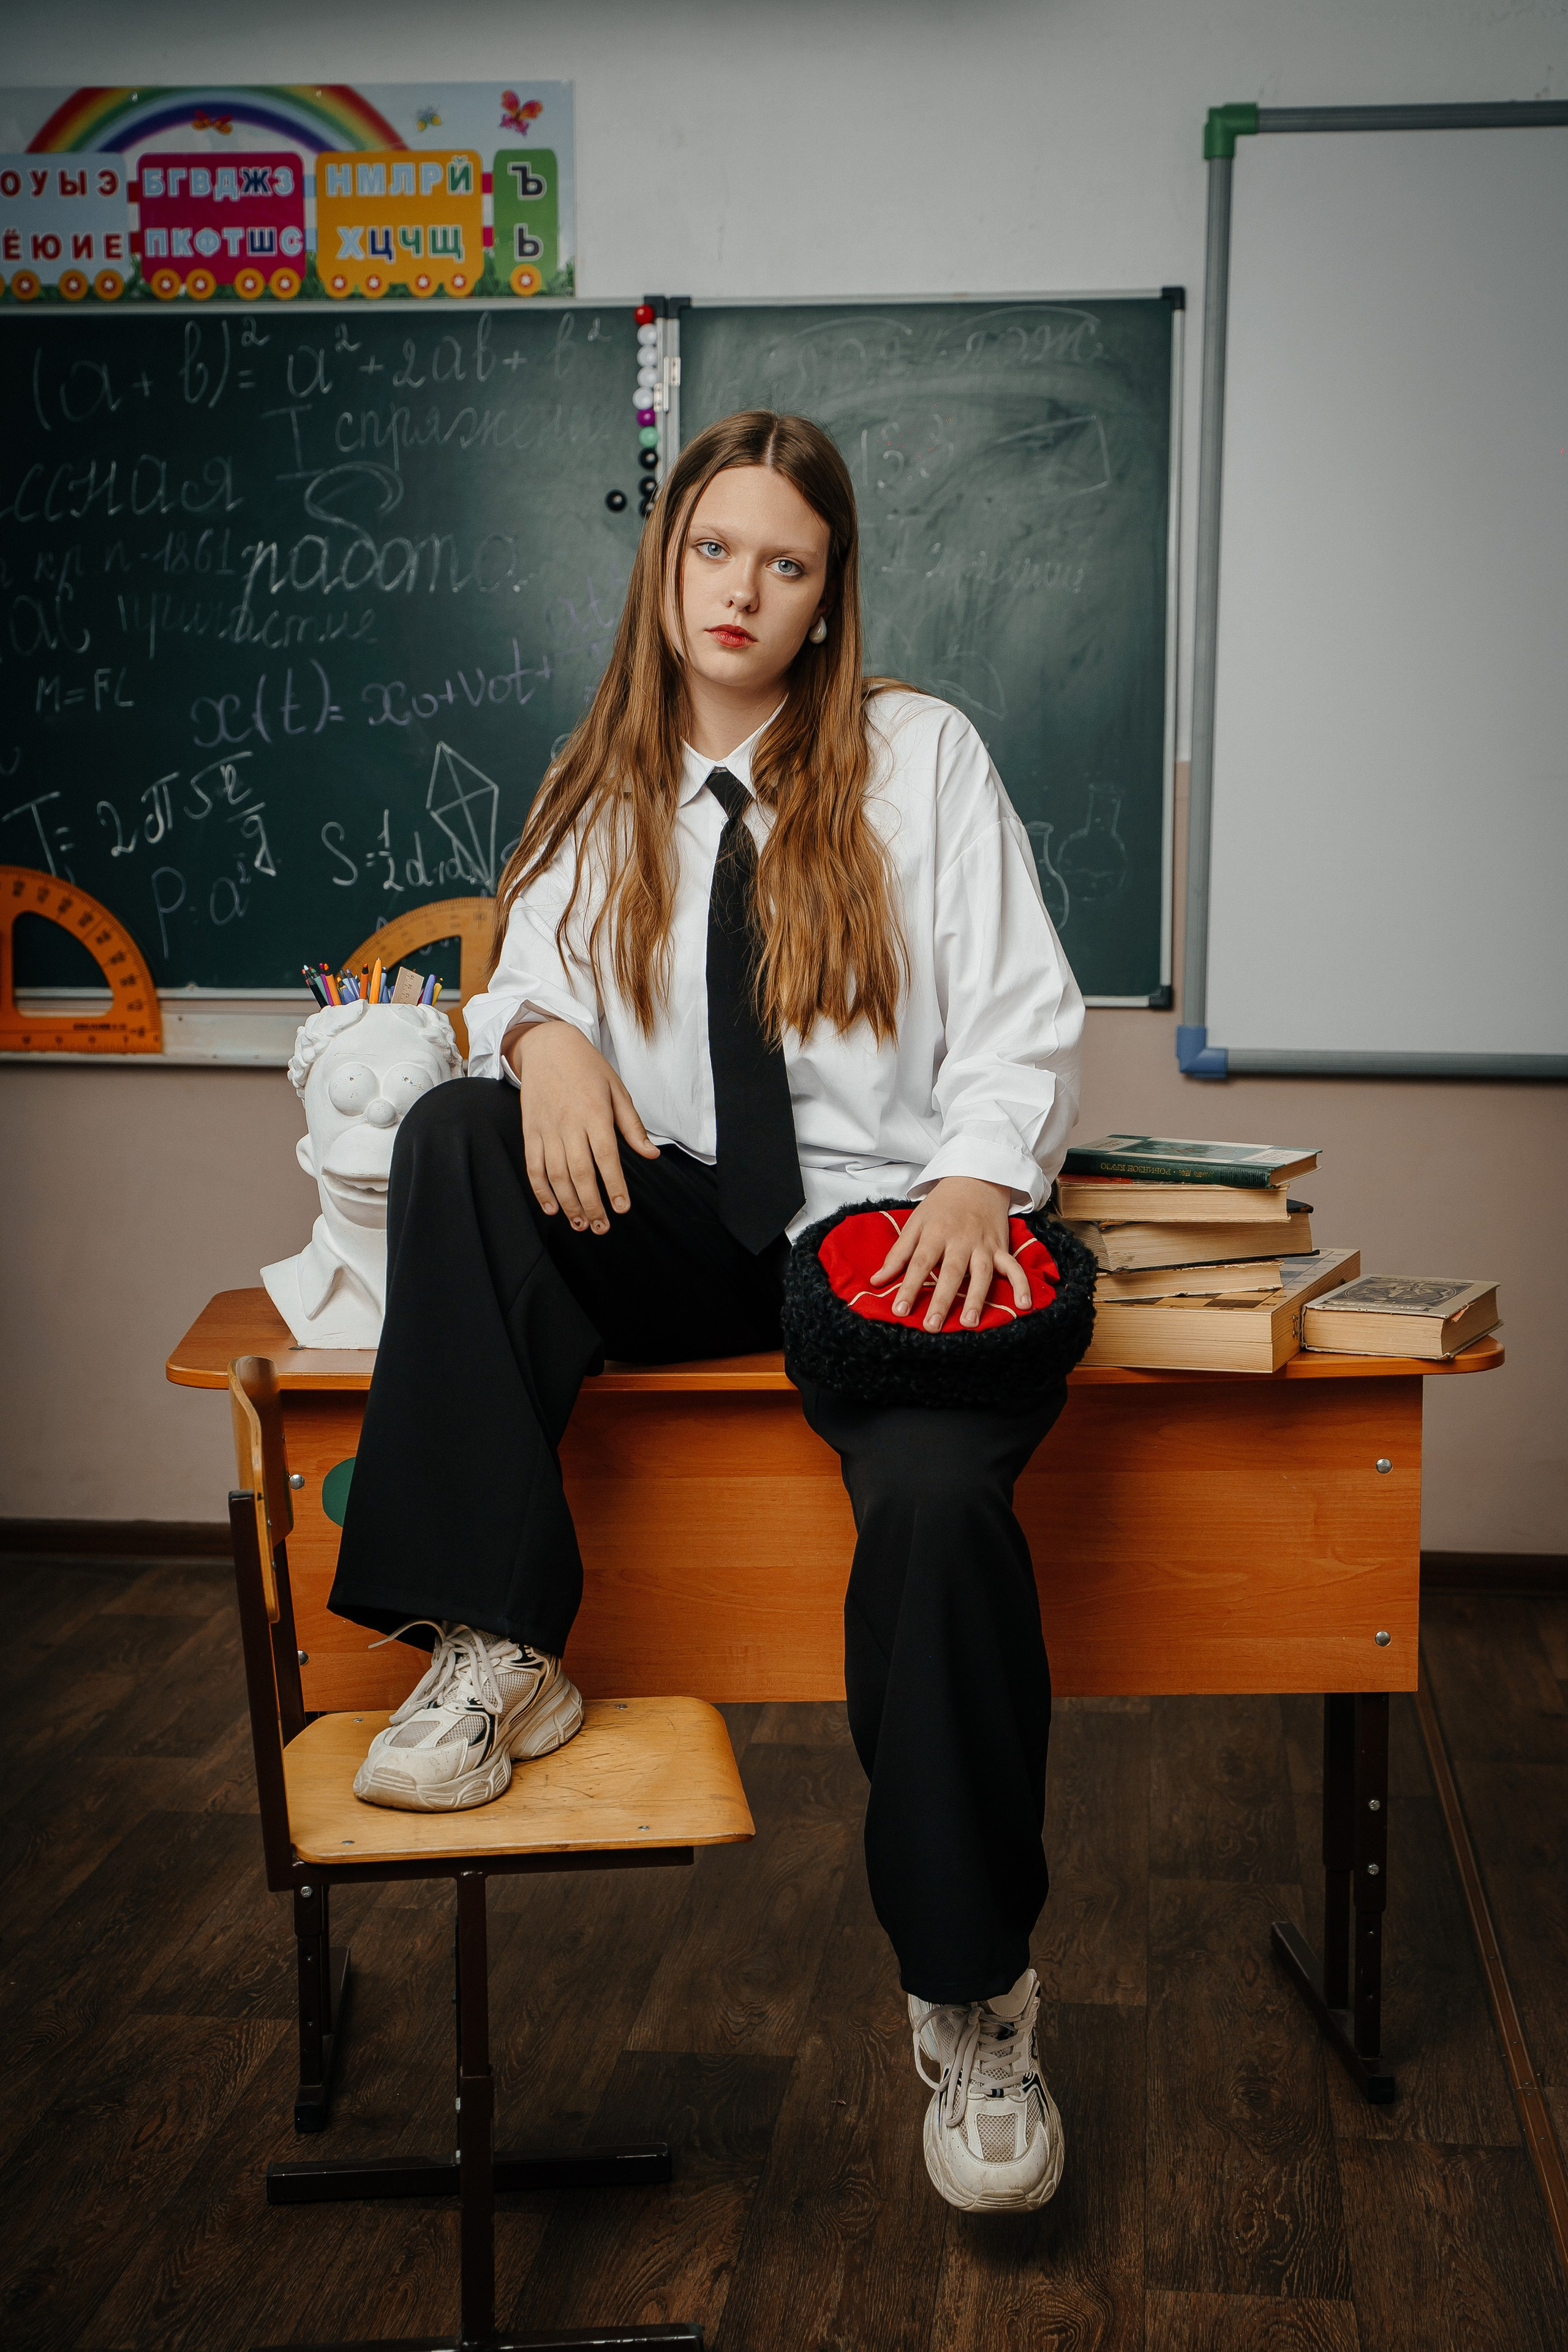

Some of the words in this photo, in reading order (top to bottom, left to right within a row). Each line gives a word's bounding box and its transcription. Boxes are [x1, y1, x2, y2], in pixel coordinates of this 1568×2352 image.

[508, 162, 546, 200] Ъ
[514, 224, 544, 261] Ь
[0, 453, 244, 522] ссная
[1100, 1162, 1125, 1172] КРУЗО
[1127, 1164, 1172, 1175] РОБИНЗОН
